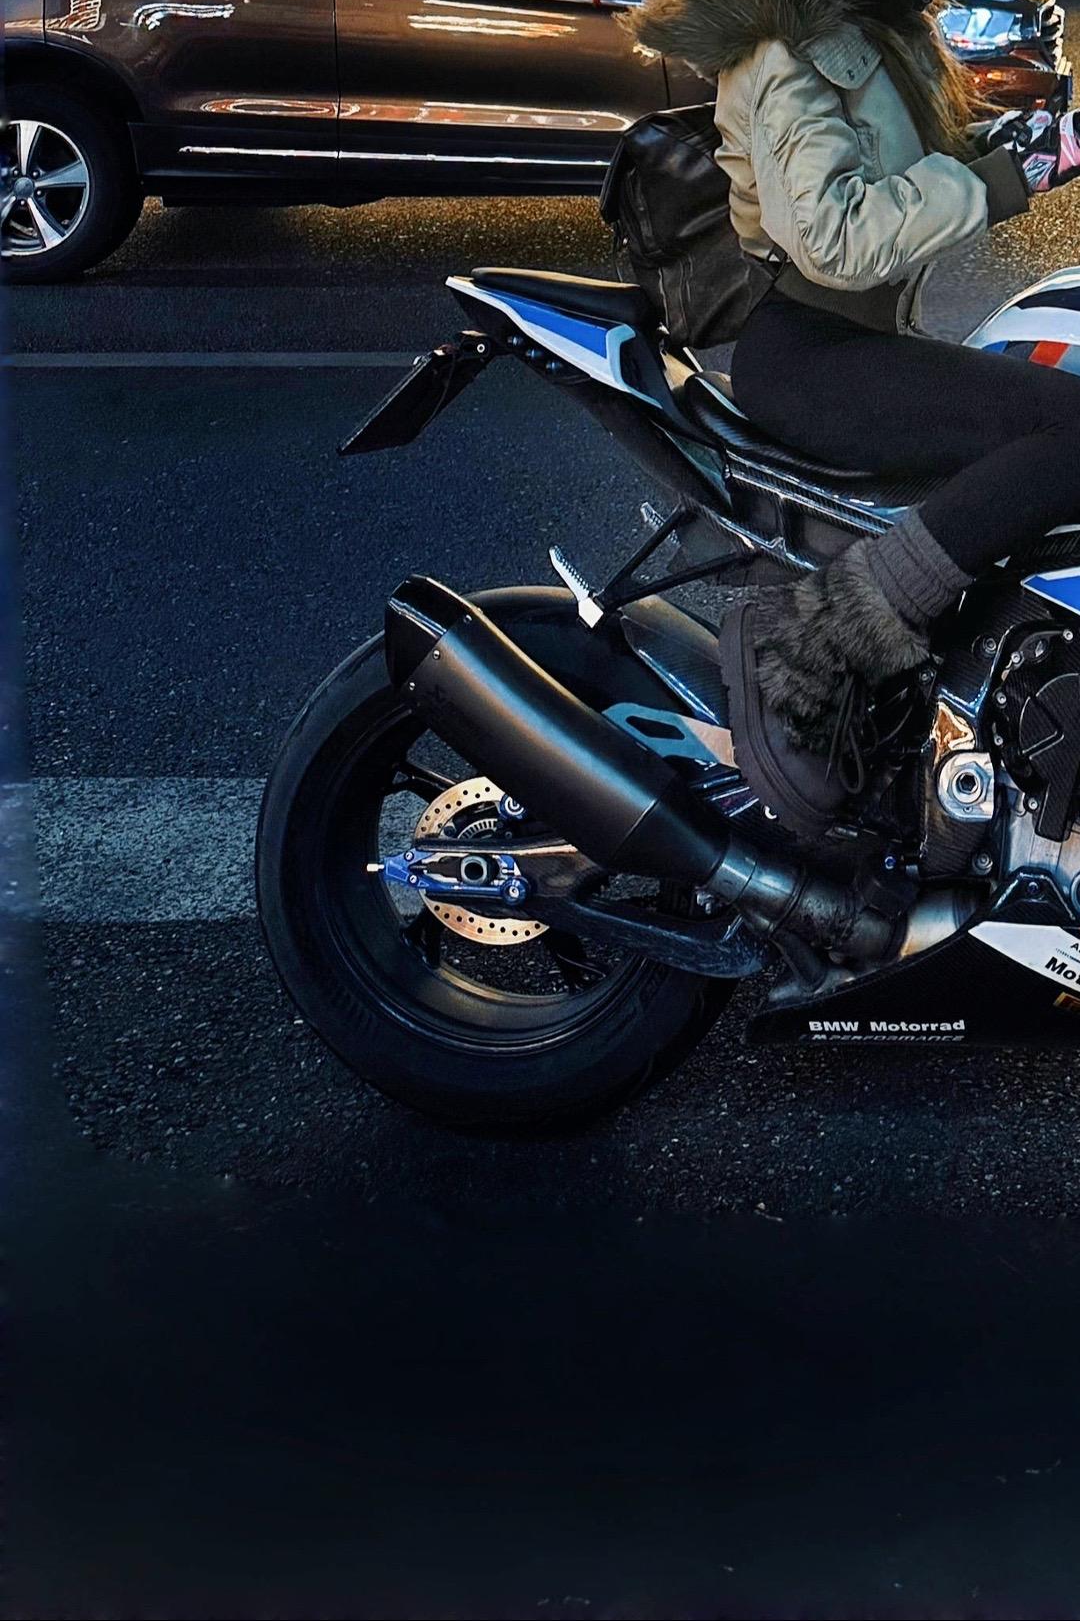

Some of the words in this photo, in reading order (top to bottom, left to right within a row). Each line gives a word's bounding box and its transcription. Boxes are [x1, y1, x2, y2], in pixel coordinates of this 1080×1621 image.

[808, 1020, 859, 1032] BMW
[870, 1019, 966, 1032] Motorrad
[829, 1034, 965, 1042] PERFORMANCE
